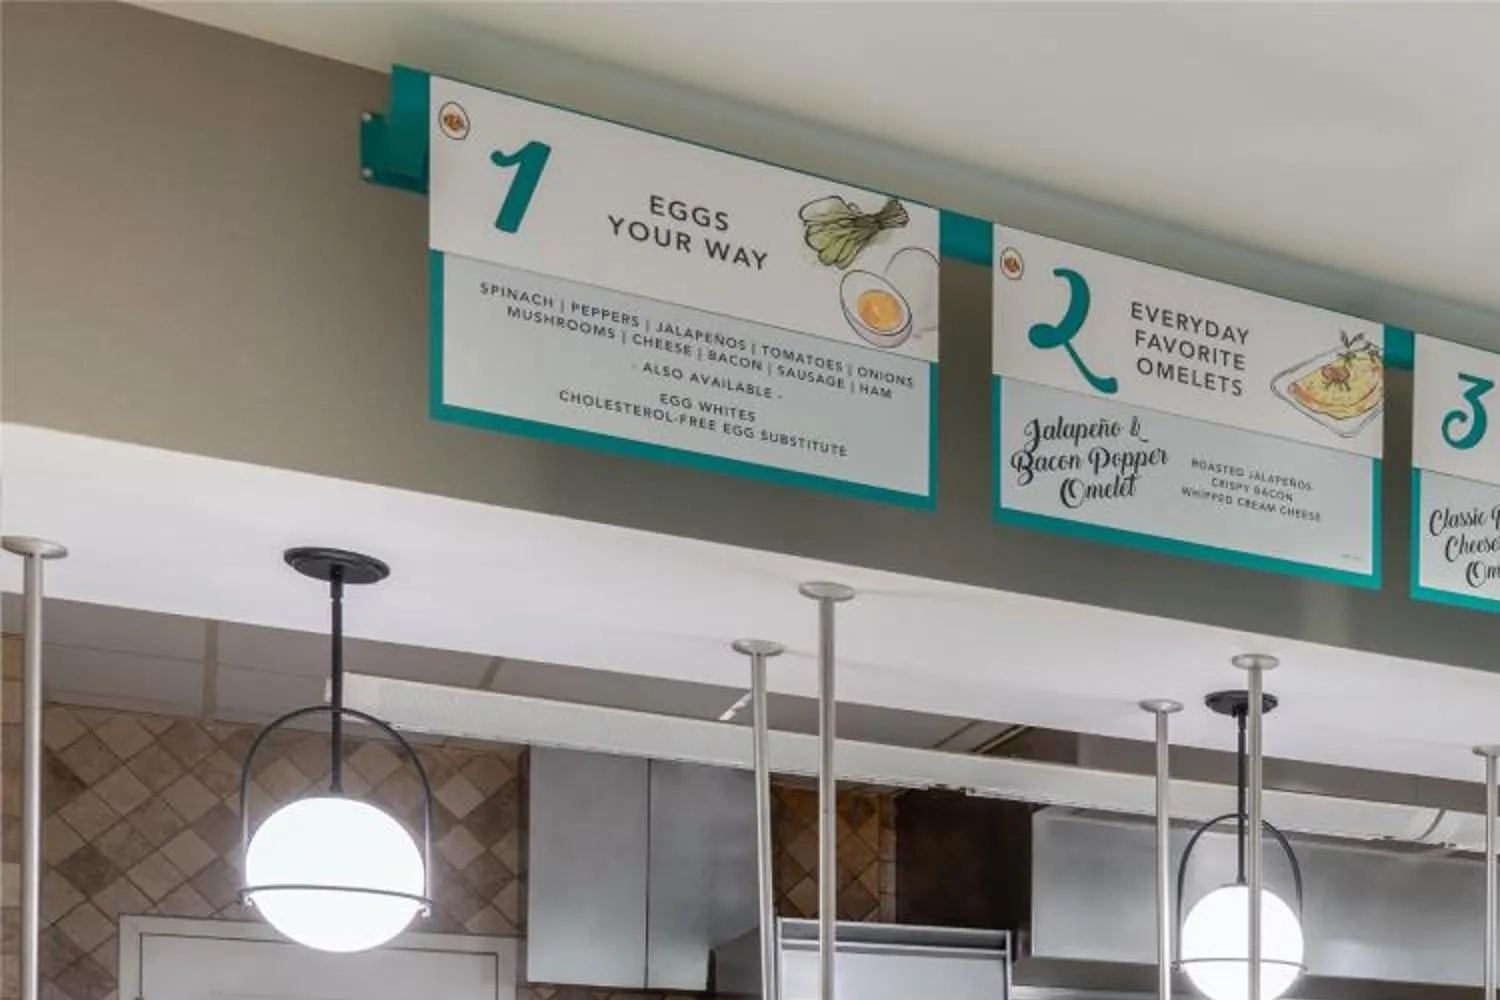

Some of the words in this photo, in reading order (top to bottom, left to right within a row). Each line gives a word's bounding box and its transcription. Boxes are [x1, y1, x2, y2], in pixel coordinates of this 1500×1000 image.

[490, 141, 551, 234] 1
[650, 195, 729, 231] EGGS
[608, 215, 692, 254] YOUR
[703, 236, 769, 271] WAY
[480, 282, 553, 308] SPINACH
[571, 301, 640, 327] PEPPERS
[762, 345, 843, 372] TOMATOES
[857, 367, 914, 388] ONIONS
[1028, 267, 1118, 394] 2
[1131, 301, 1249, 345] EVERYDAY
[507, 306, 615, 339] MUSHROOMS
[632, 333, 692, 356] CHEESE
[708, 350, 763, 372] BACON
[777, 365, 845, 389] SAUSAGE
[859, 383, 893, 399] HAM
[1135, 328, 1245, 371] FAVORITE
[643, 362, 684, 380] ALSO
[689, 372, 772, 399] AVAILABLE
[1137, 357, 1242, 397] OMELETS
[559, 389, 717, 431] CHOLESTEROL-FREE
[723, 423, 755, 439] EGG
[760, 429, 848, 457] SUBSTITUTE
[659, 393, 693, 409] EGG
[699, 401, 756, 422] WHITES
[1441, 372, 1495, 450] 3
[1010, 450, 1081, 486] Bacon
[1088, 446, 1168, 475] Popper
[1191, 457, 1245, 477] ROASTED
[1060, 473, 1141, 509] Omelet
[1211, 477, 1249, 493] CRISPY
[1253, 486, 1293, 502] BACON
[1237, 497, 1277, 513] CREAM
[1280, 505, 1321, 522] CHEESE
[1429, 507, 1485, 536] Classic
